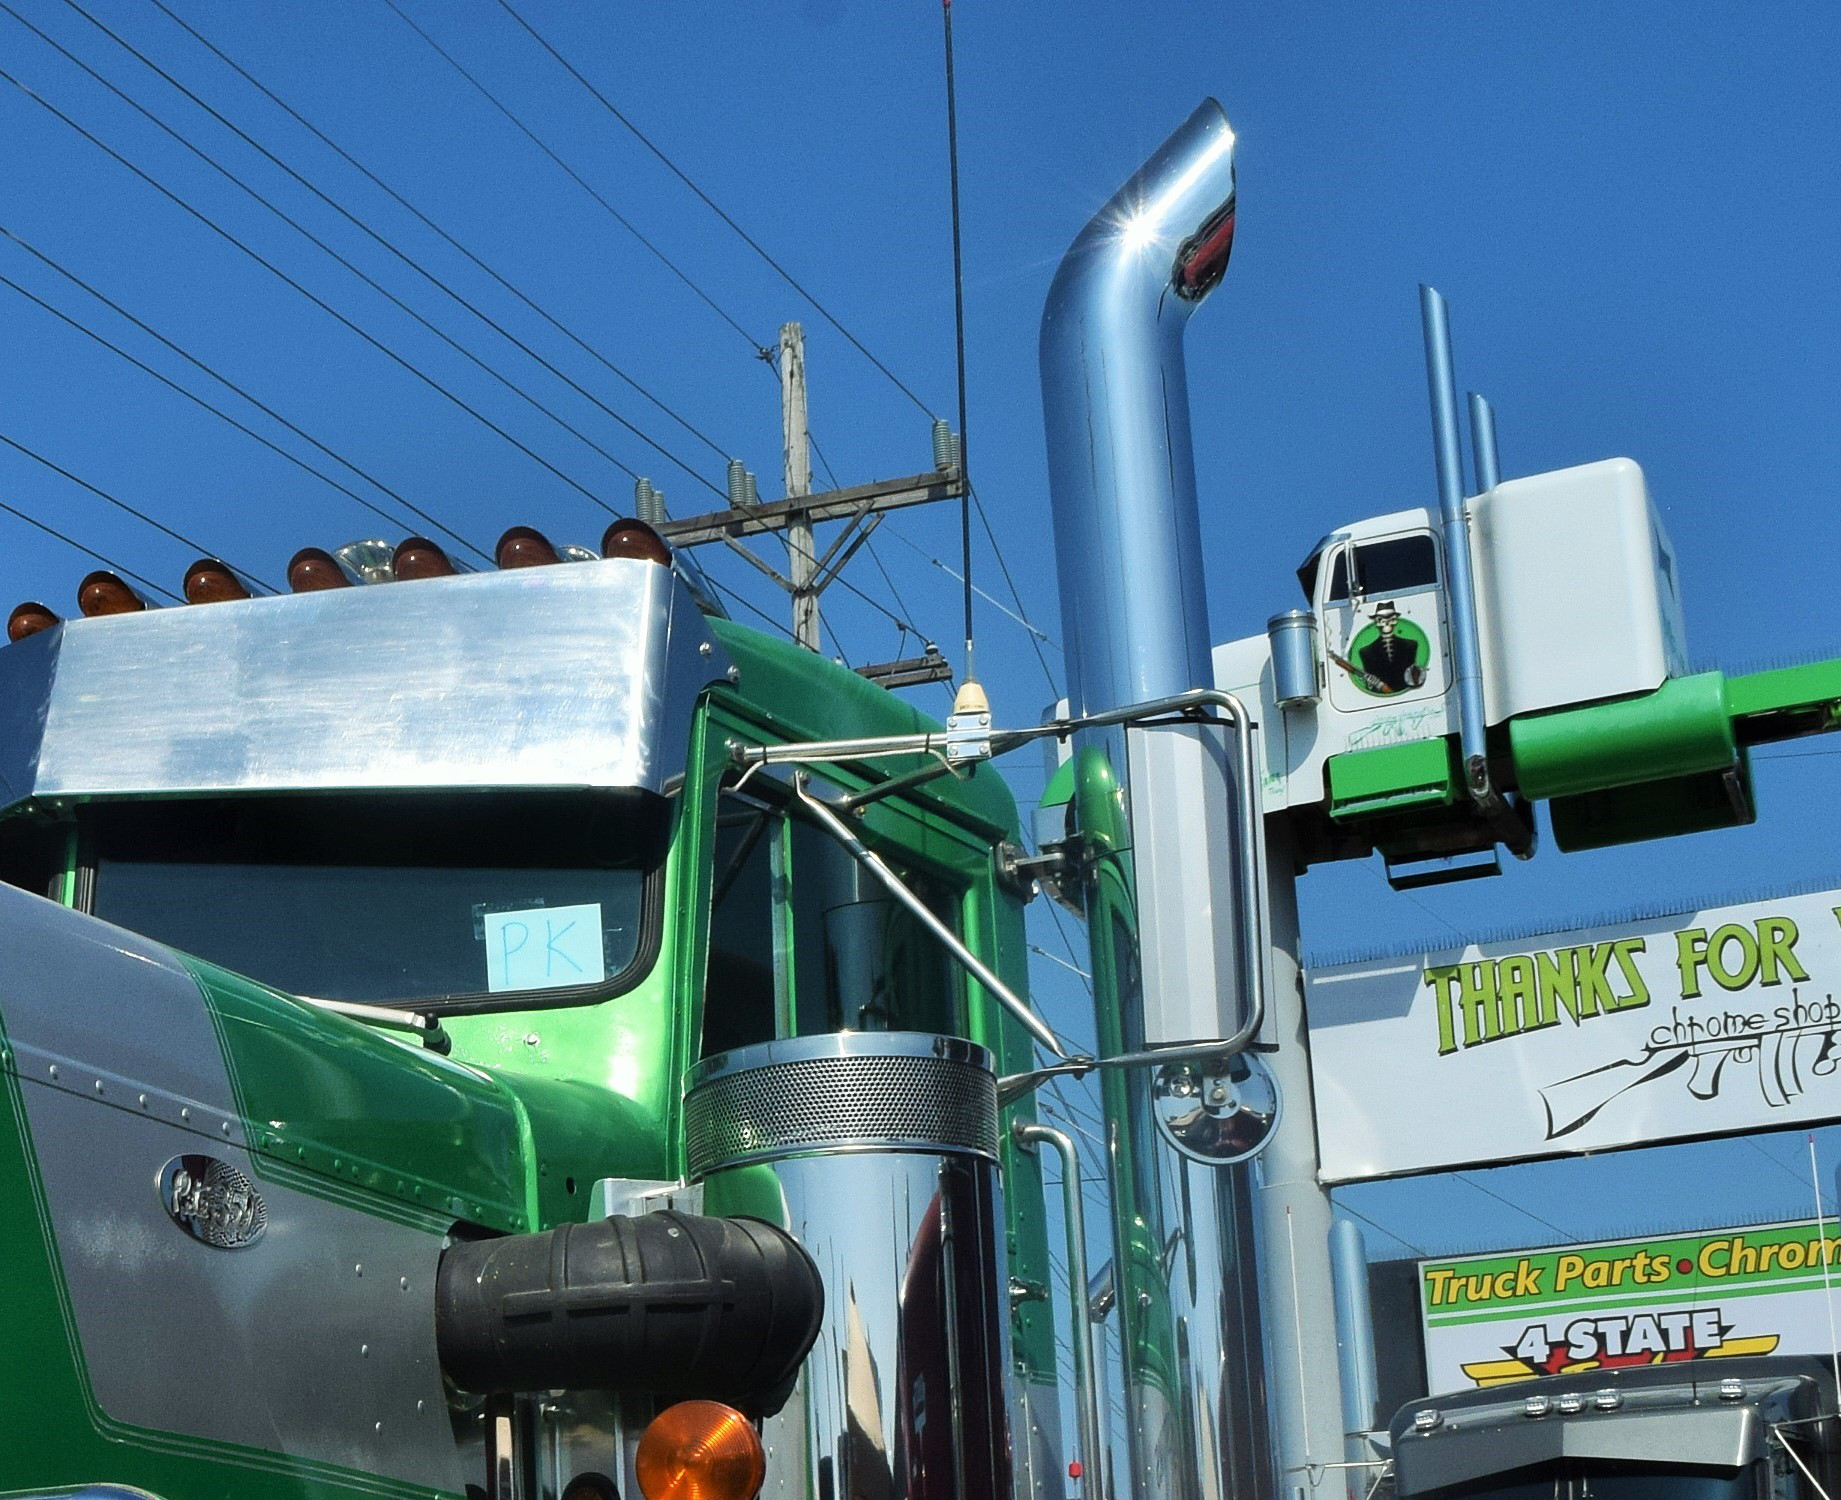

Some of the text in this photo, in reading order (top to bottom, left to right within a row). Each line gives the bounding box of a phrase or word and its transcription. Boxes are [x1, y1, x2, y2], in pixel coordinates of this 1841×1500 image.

[1424, 916, 1811, 1056] THANKS FOR
[1650, 987, 1841, 1048] chrome shop
[1425, 1260, 1545, 1306] Truck
[1554, 1247, 1671, 1292] Parts
[1514, 1308, 1724, 1366] 4 STATE
